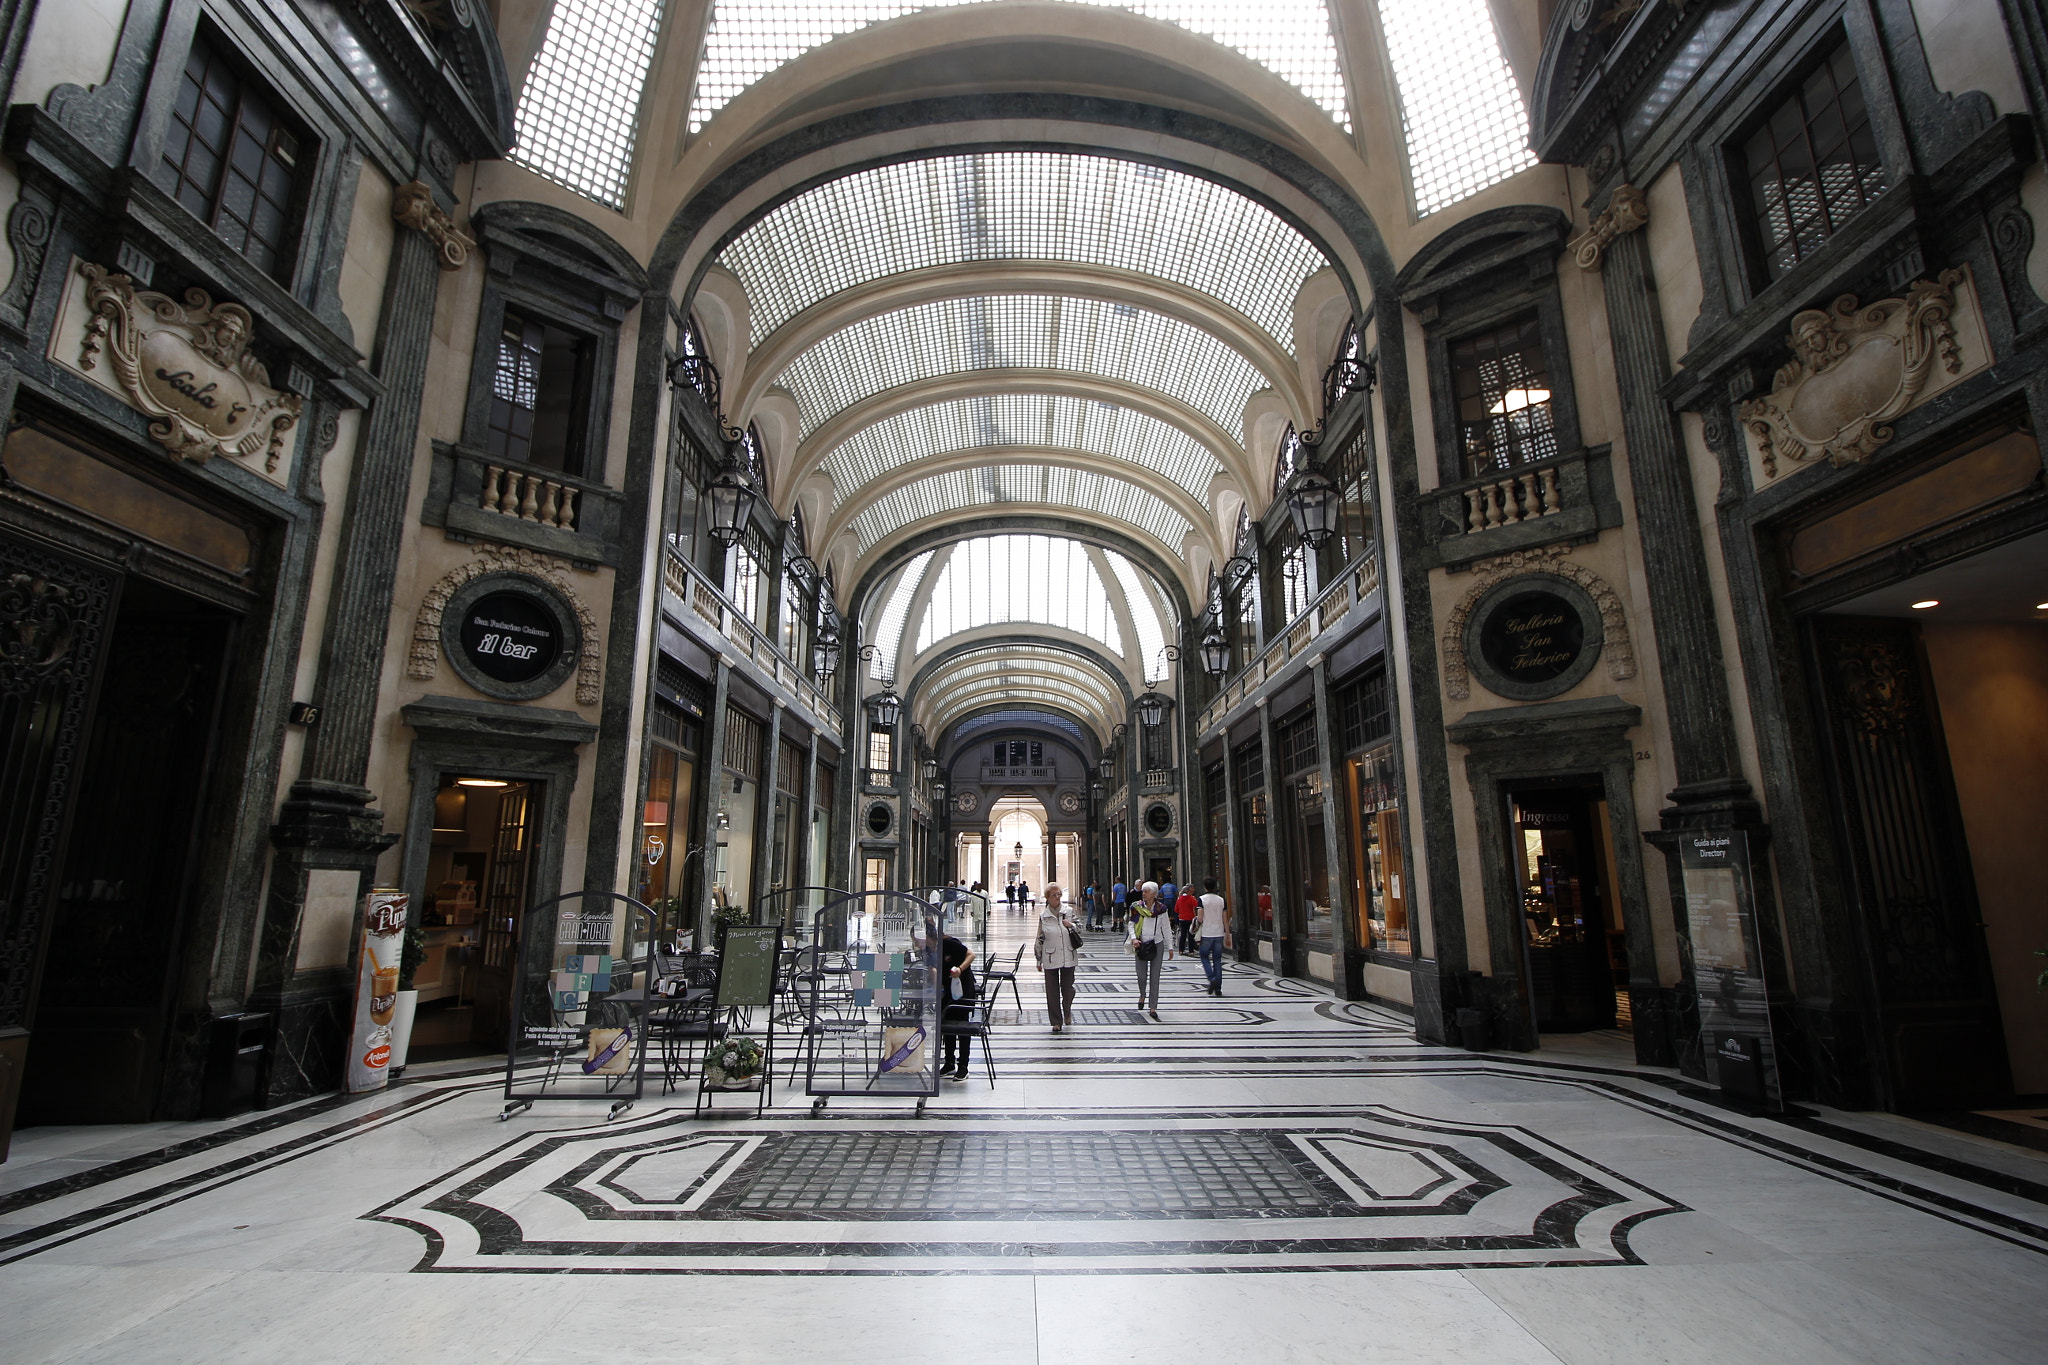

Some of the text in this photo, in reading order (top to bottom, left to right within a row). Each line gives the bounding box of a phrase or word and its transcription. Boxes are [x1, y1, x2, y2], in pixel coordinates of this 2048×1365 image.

[155, 368, 219, 409] Scala
[1505, 614, 1565, 635] Galleria
[477, 634, 537, 660] il bar
[1520, 632, 1552, 650] San
[1510, 652, 1571, 671] Federico
[299, 706, 318, 724] 16
[1636, 750, 1651, 761] 26
[1522, 810, 1569, 826] Ingresso
[1693, 838, 1710, 847] Guida
[1716, 836, 1730, 848] piani
[1700, 849, 1726, 858] Directory
[560, 921, 616, 940] GRAN TORINO
[568, 956, 580, 972] S
[577, 974, 588, 990] F
[563, 992, 577, 1006] C
